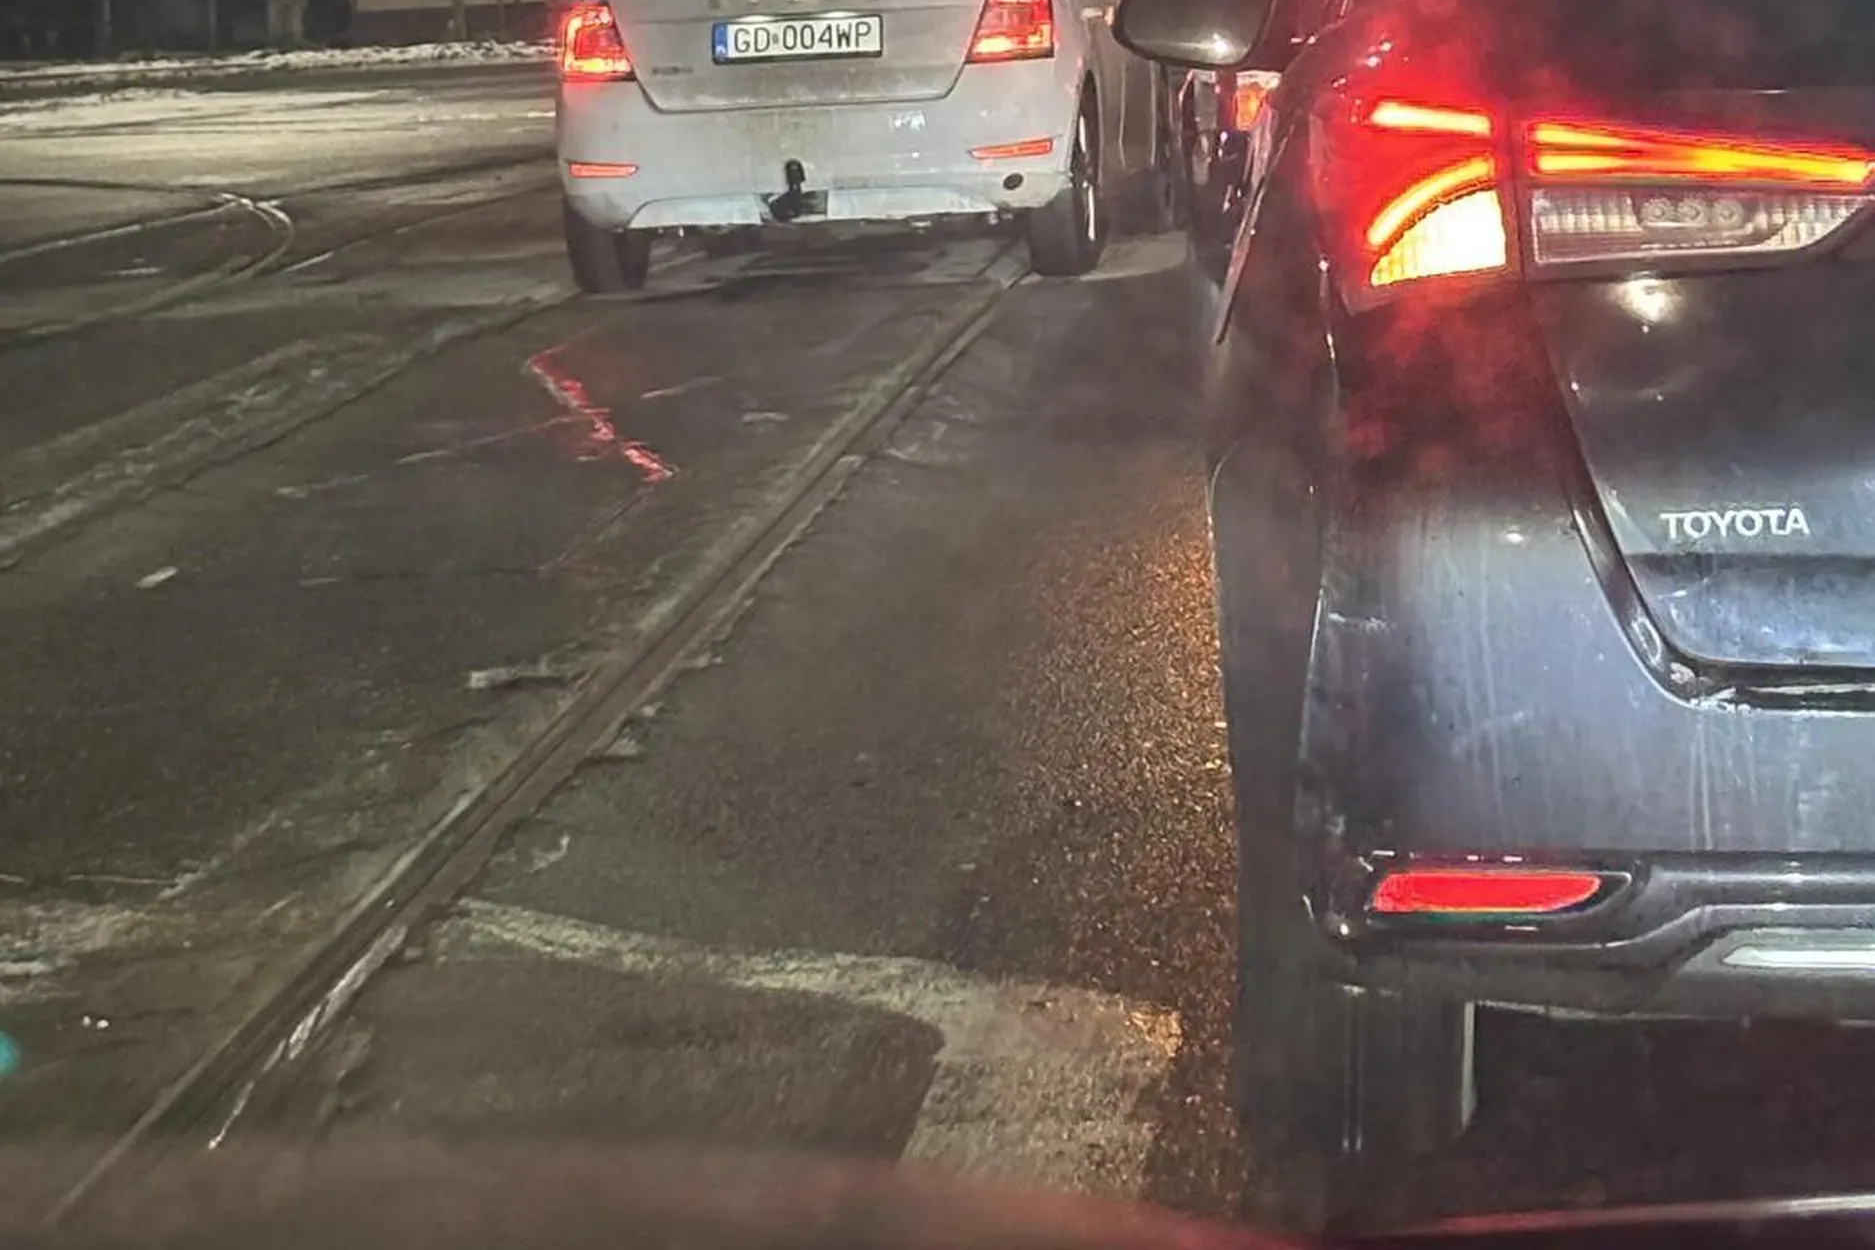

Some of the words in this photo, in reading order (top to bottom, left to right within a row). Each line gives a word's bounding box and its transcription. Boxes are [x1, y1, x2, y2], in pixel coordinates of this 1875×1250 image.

[734, 27, 770, 53] GD
[782, 21, 872, 51] 004WP
[1659, 508, 1810, 539] TOYOTA
